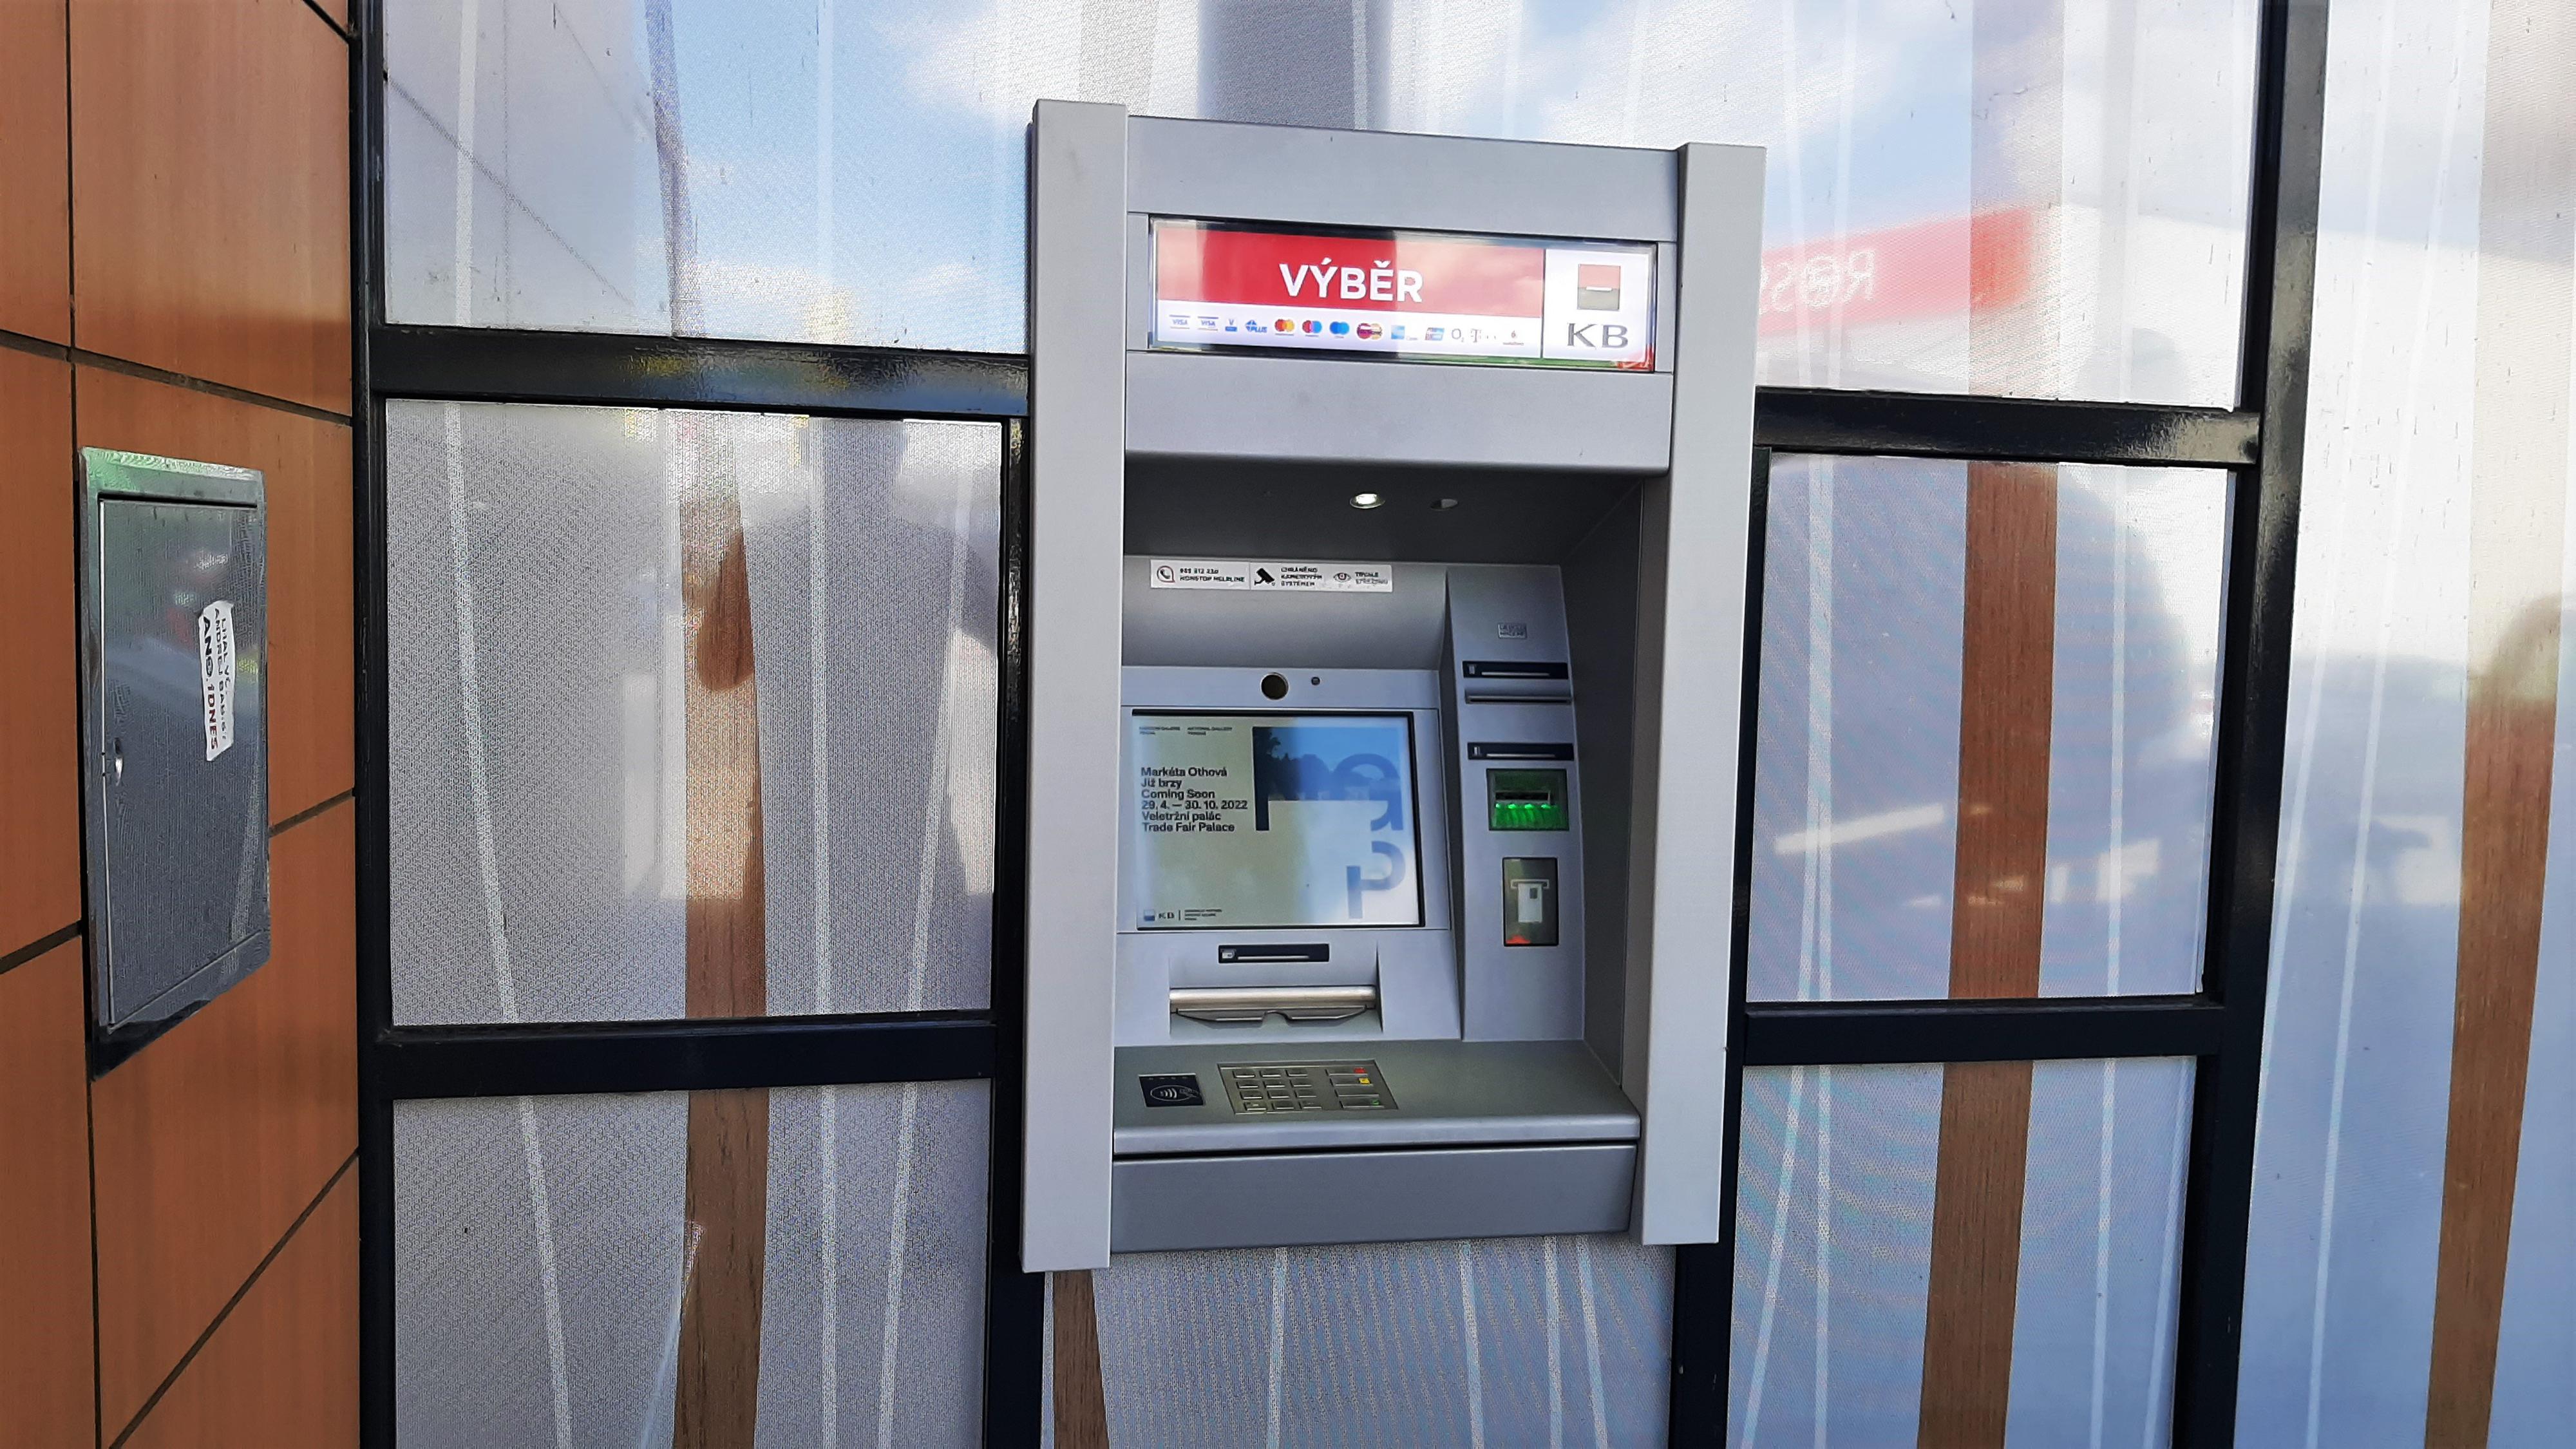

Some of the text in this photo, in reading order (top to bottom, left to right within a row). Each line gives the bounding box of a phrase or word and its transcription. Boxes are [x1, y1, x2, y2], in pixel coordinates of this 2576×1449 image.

[1279, 257, 1423, 302] VÝBĚR
[1567, 323, 1628, 348] KB
[215, 608, 223, 676] ANDREJ
[1141, 766, 1227, 777] Markéta Othová
[1141, 777, 1182, 790] Již brzy
[1141, 789, 1215, 800] Coming Soon
[1185, 800, 1202, 810] 30.
[1205, 800, 1218, 810] 10.
[1221, 800, 1248, 810] 2022
[1192, 811, 1222, 822] palác
[1142, 822, 1235, 832] Trade Fair Palace
